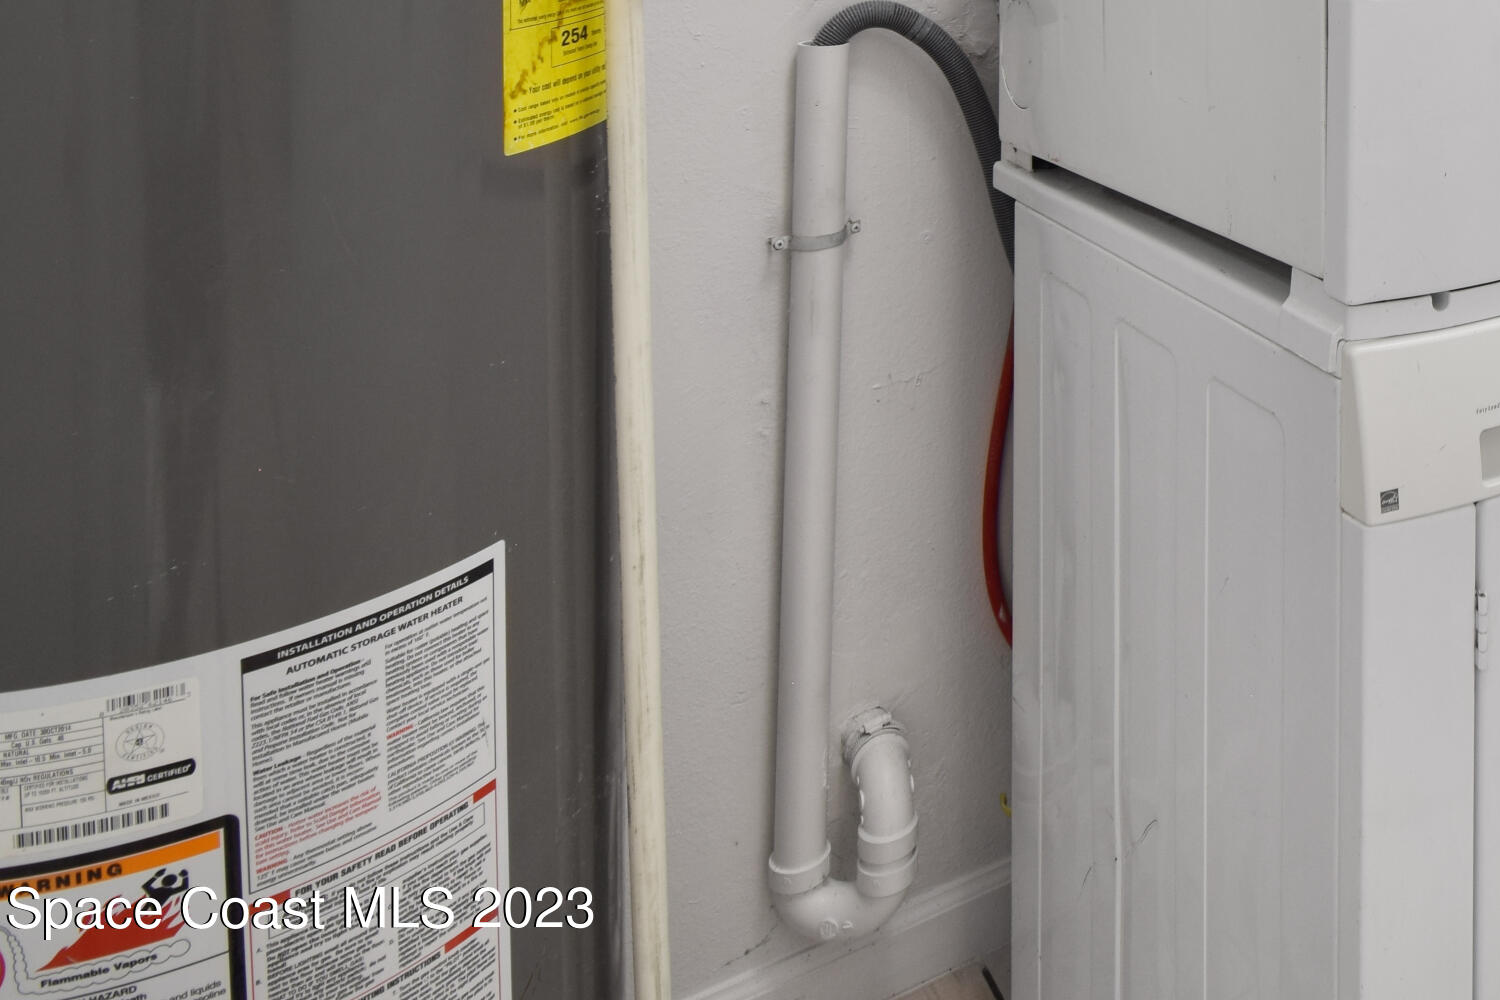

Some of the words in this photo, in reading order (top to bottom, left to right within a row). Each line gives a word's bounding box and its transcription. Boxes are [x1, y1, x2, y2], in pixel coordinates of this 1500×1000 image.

[561, 25, 588, 46] 254
[277, 626, 351, 659] INSTALLATION
[355, 617, 376, 632] AND
[379, 592, 432, 622] OPERATION
[435, 575, 468, 598] DETAILS
[286, 646, 347, 675] AUTOMATIC
[350, 626, 396, 652] STORAGE
[398, 611, 428, 632] WATER
[431, 595, 462, 617] HEATER
[146, 764, 187, 782] CERTIFIED
[295, 883, 311, 896] FOR
[315, 871, 338, 888] YOUR
[340, 855, 372, 876] SAFETY
[374, 844, 395, 860] READ
[398, 826, 427, 848] BEFORE
[429, 801, 468, 830] OPERATING
[40, 966, 109, 988] Flammable
[114, 953, 157, 971] Vapors
[190, 979, 221, 997] liquids
